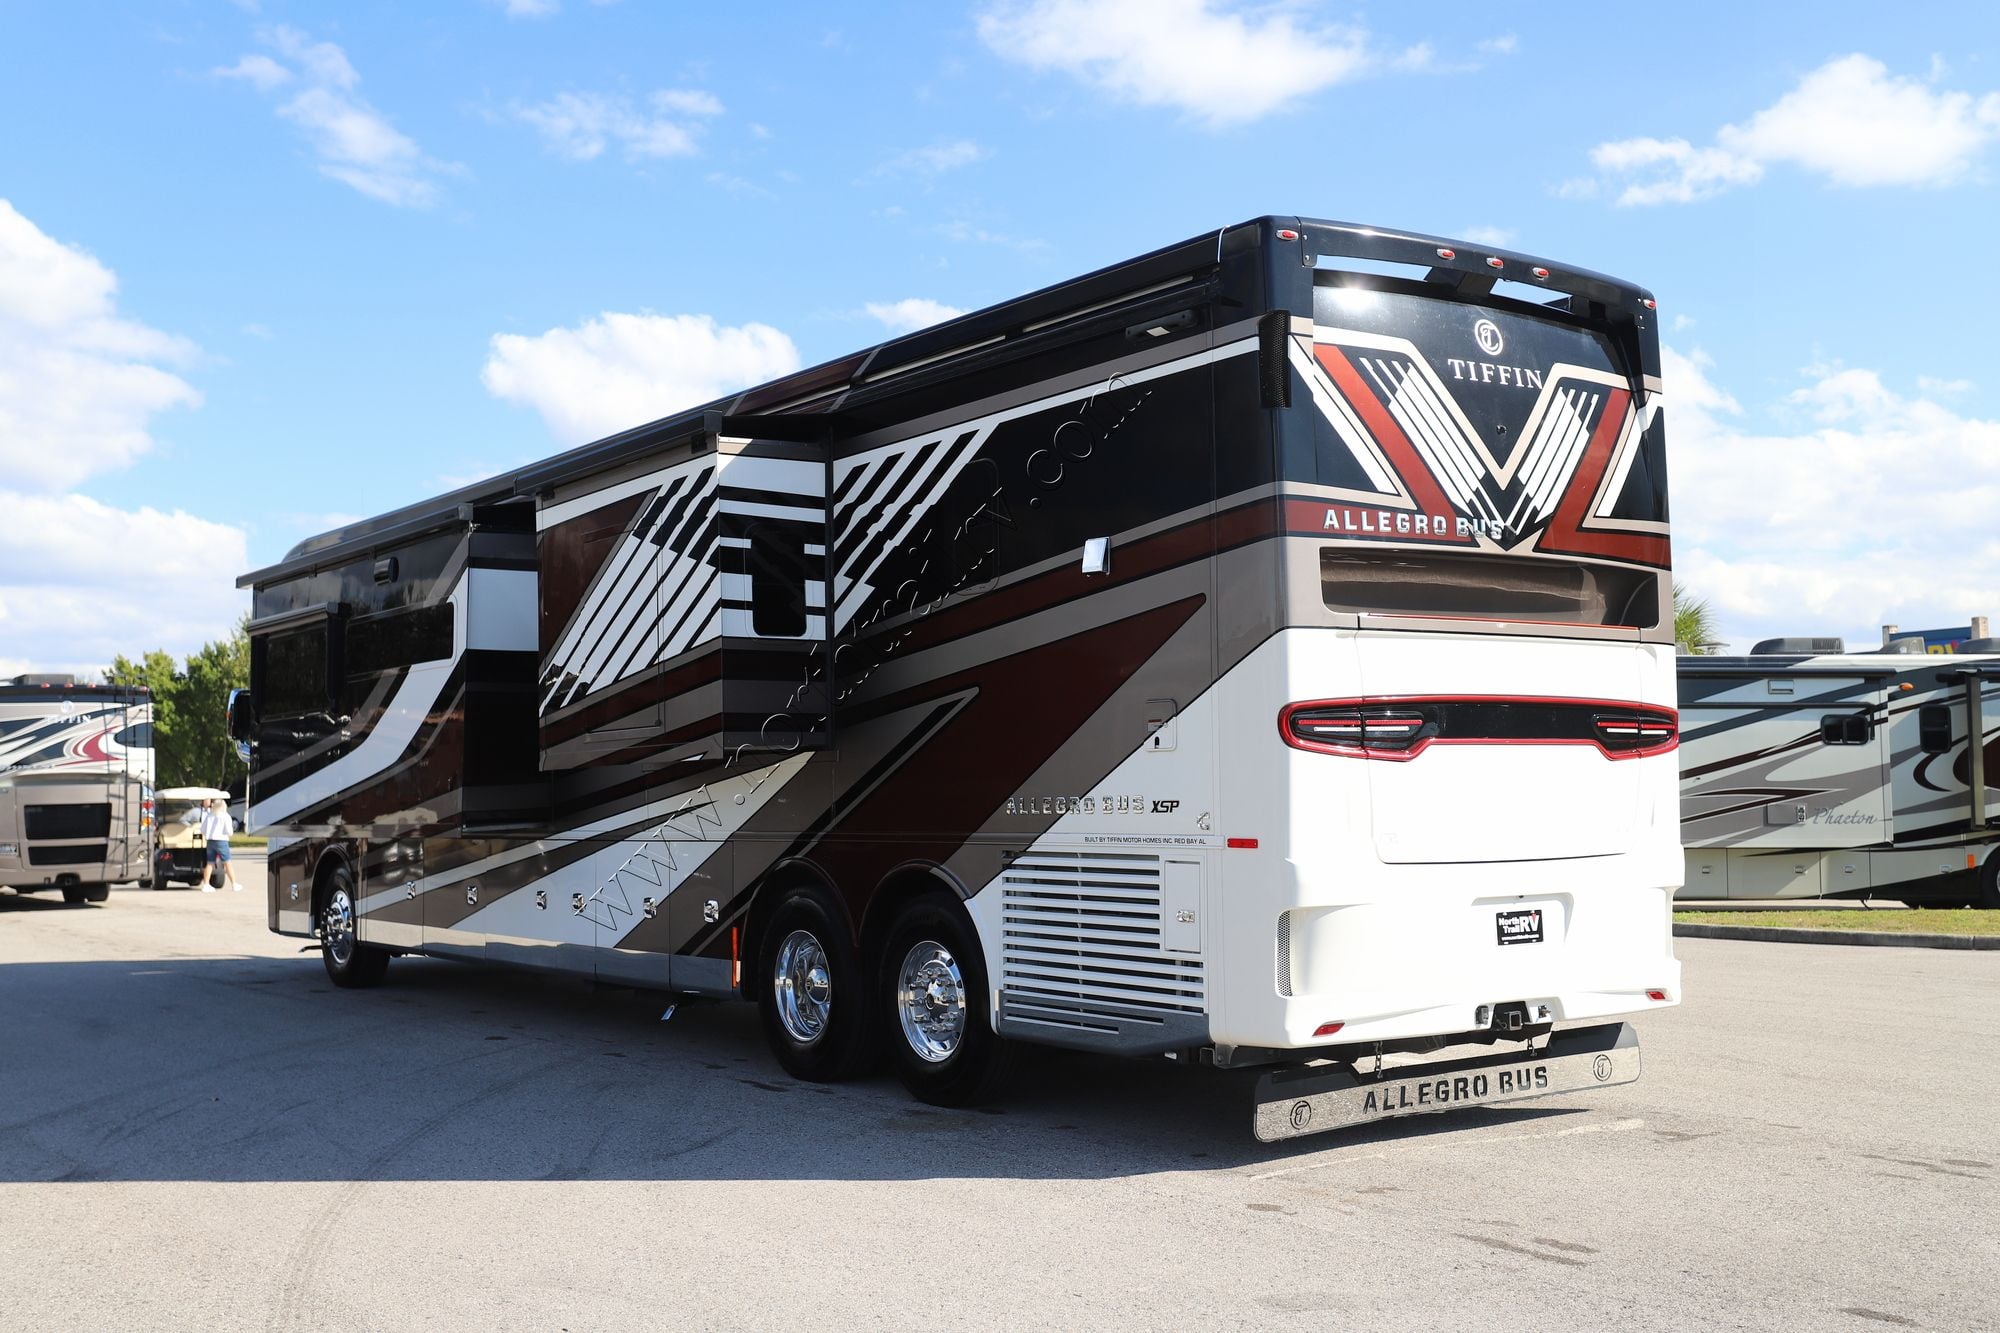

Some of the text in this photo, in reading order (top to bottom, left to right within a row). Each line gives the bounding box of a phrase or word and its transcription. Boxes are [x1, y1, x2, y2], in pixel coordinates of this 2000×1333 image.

[1447, 358, 1543, 390] TIFFIN
[1323, 509, 1503, 540] ALLEGRO BUS
[1006, 795, 1180, 815] ALLEGRO BUS XSP
[1812, 807, 1878, 825] Phaeton
[1498, 916, 1520, 926] North
[1502, 924, 1520, 934] Trail
[1519, 914, 1540, 932] RV
[1362, 1066, 1548, 1115] ALLEGRO BUS
